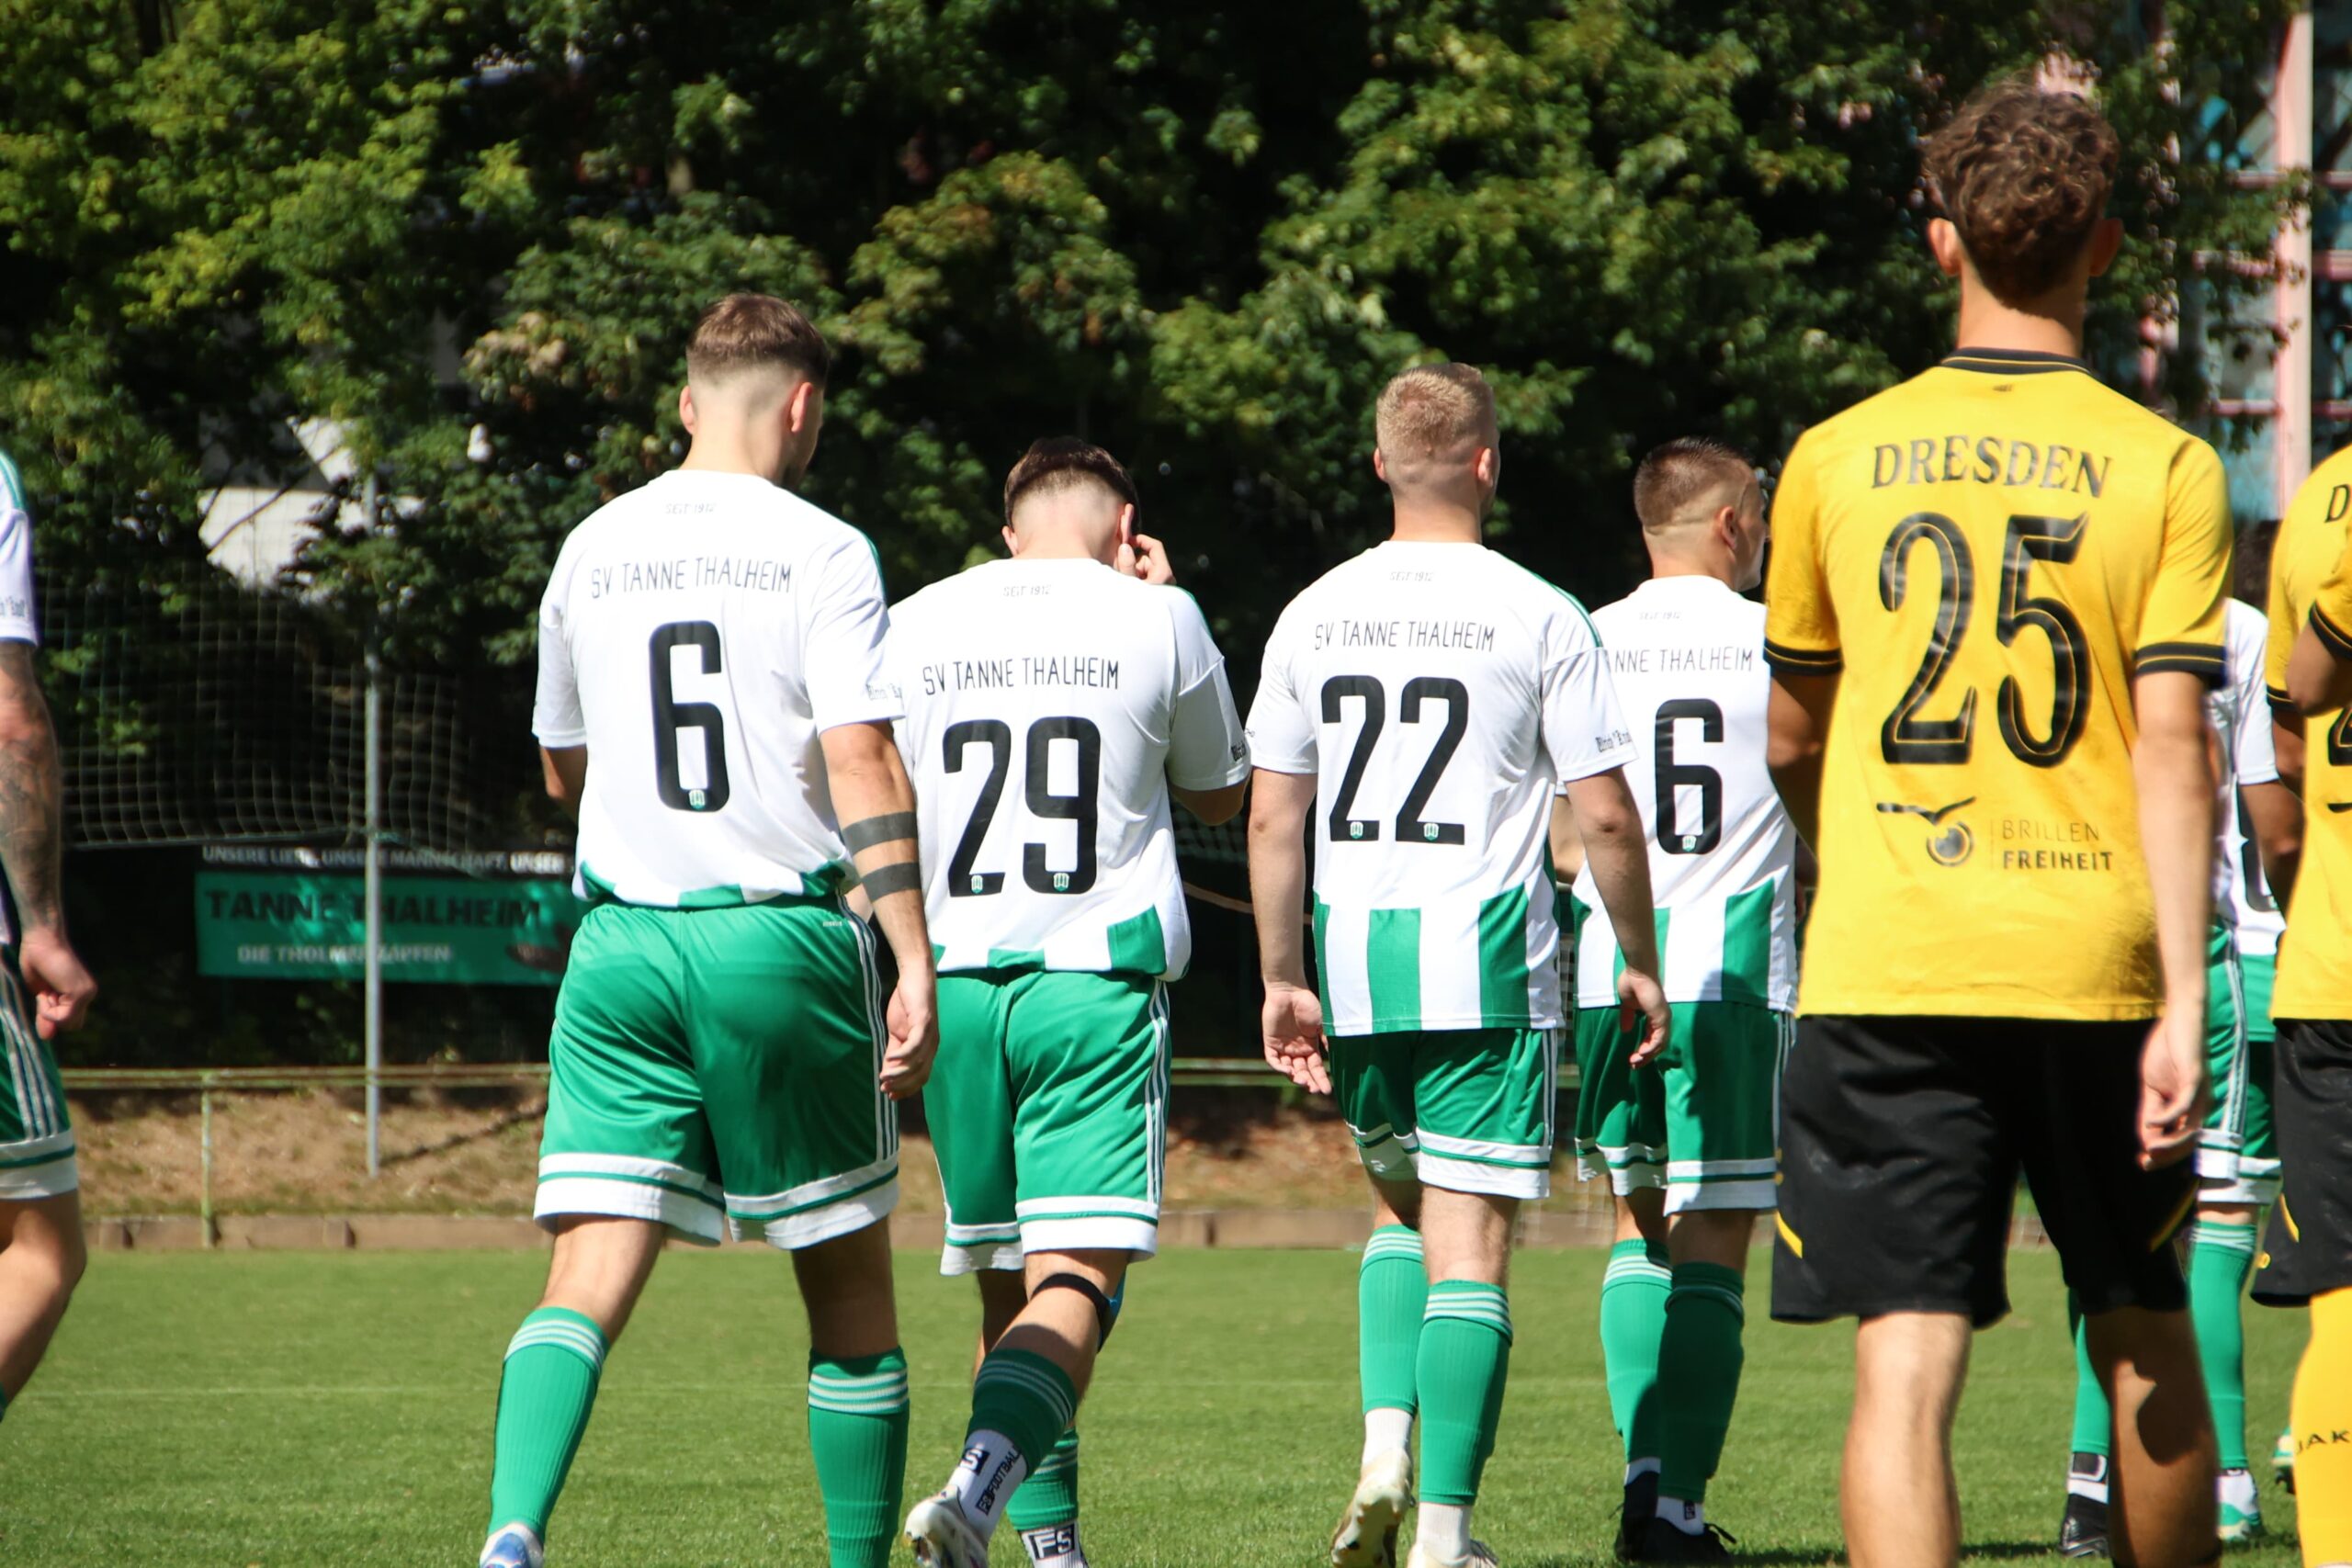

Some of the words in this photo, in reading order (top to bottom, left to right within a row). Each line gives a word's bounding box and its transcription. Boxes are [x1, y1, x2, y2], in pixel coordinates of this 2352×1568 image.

[1871, 434, 2112, 499] DRESDEN
[592, 566, 614, 599] SV
[623, 559, 687, 592] TANNE
[695, 556, 793, 594] THALHEIM
[1315, 622, 1335, 650] SV
[1342, 620, 1400, 647] TANNE
[1408, 620, 1496, 652] THALHEIM
[1879, 511, 2093, 769] 25
[922, 666, 946, 695] SV
[953, 659, 1013, 691] TANNE
[1022, 655, 1120, 691] THALHEIM
[1612, 649, 1651, 673] NNE
[1659, 646, 1754, 672] THALHEIM
[649, 620, 730, 813] 6
[1320, 674, 1469, 846] 22
[1655, 698, 1725, 856] 6
[943, 716, 1102, 898] 29
[2002, 819, 2100, 842] BRILLEN
[2003, 850, 2112, 871] FREIHEIT
[237, 944, 270, 964] DIE
[2297, 1430, 2350, 1454] JAK
[1031, 1525, 1074, 1560] FS
